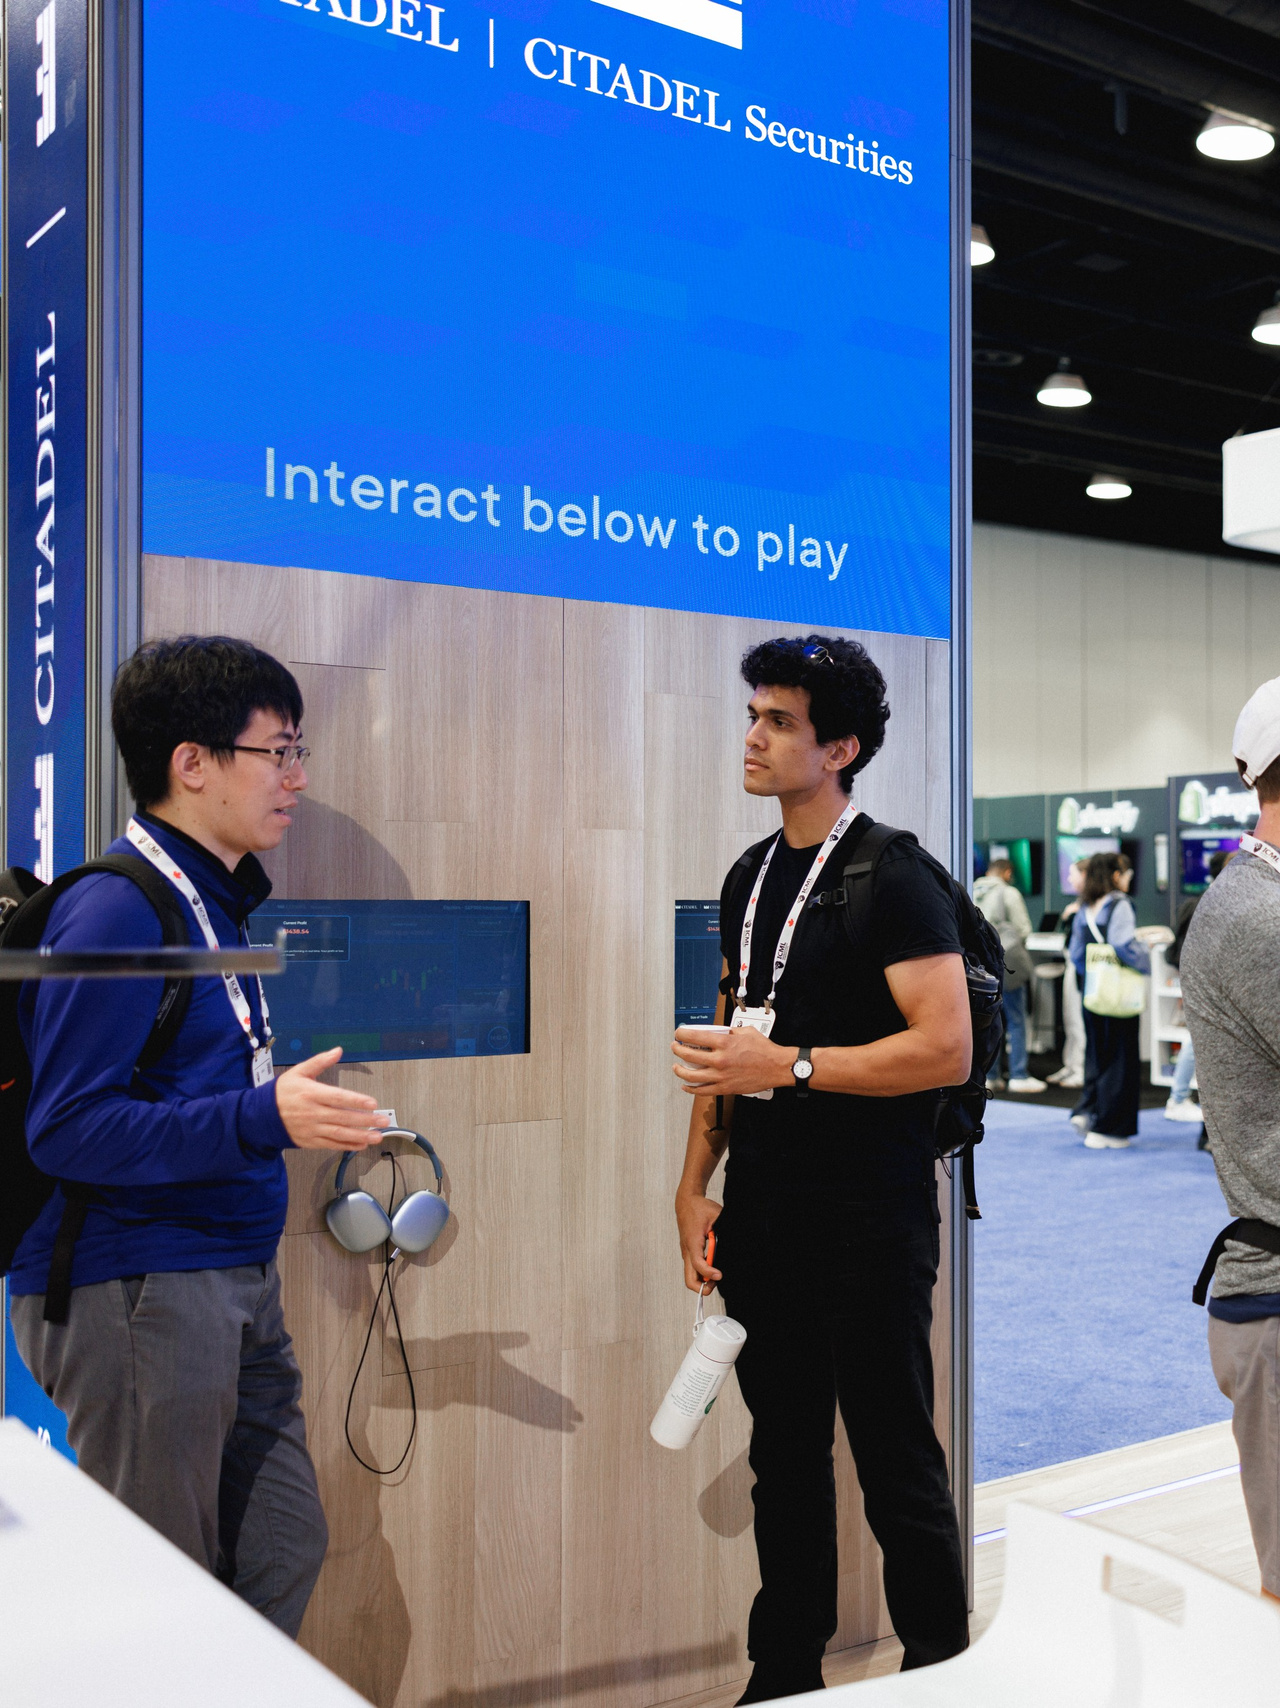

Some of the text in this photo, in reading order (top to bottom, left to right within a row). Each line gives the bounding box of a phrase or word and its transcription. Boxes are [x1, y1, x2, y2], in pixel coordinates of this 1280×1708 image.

[524, 37, 732, 133] CITADEL
[745, 104, 914, 186] Securities
[35, 311, 56, 726] CITADEL
[265, 447, 849, 581] Interact below to play
[834, 818, 847, 834] ICML
[146, 838, 162, 858] ICML
[1262, 847, 1280, 863] ICML
[802, 877, 814, 893] ICML
[777, 942, 787, 960] ICML
[230, 979, 241, 1000] ICML
